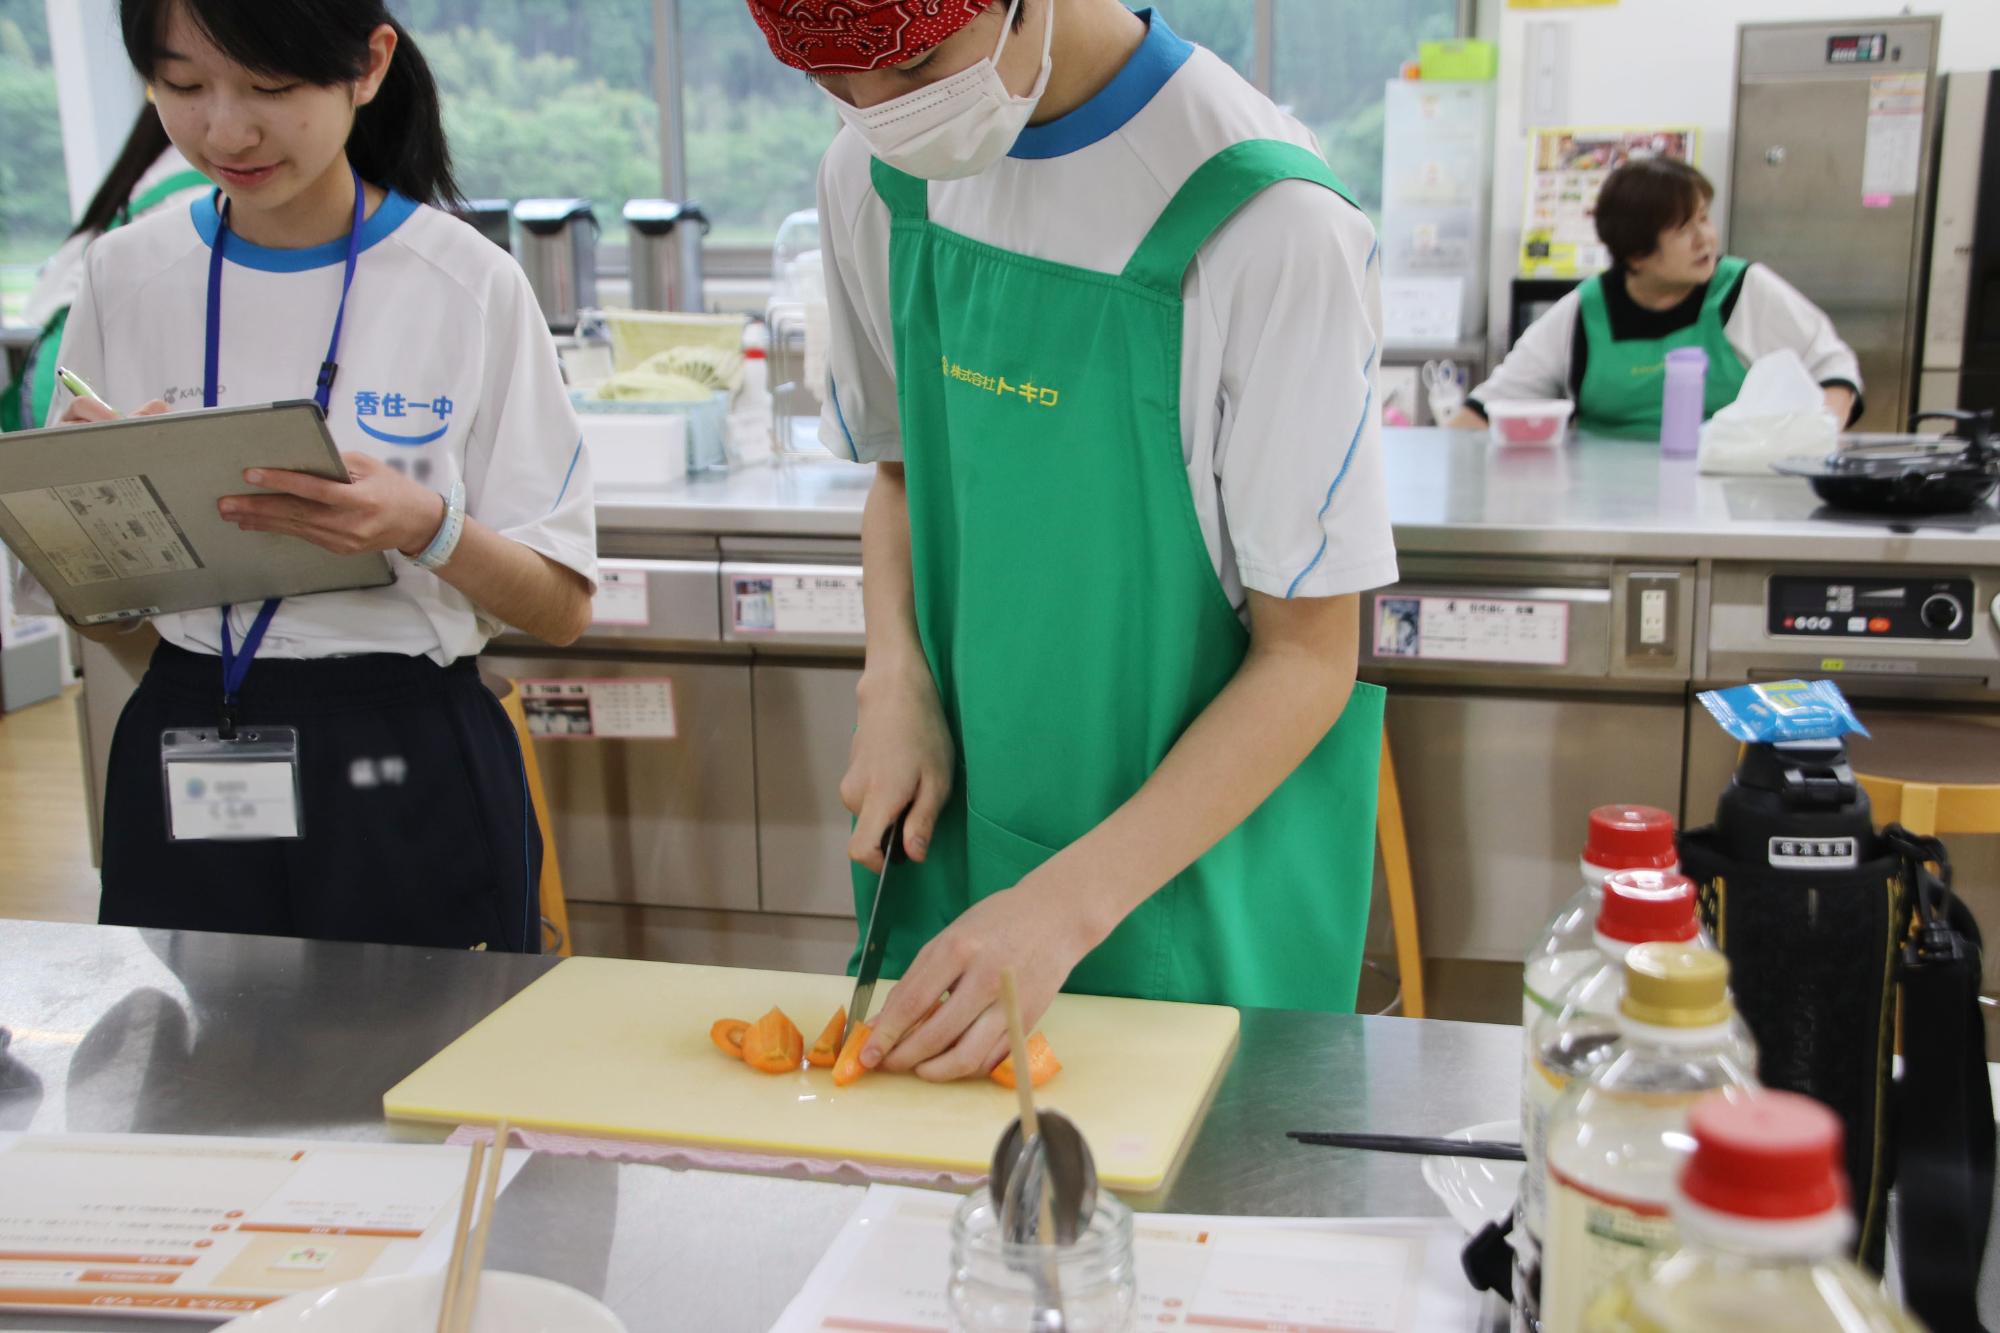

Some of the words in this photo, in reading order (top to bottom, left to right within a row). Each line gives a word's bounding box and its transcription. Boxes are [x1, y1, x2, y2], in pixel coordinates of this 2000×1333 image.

[180, 384, 226, 399] KANO
[354, 392, 453, 420] 香住一中
[1781, 841, 1846, 855] 保冷専用
